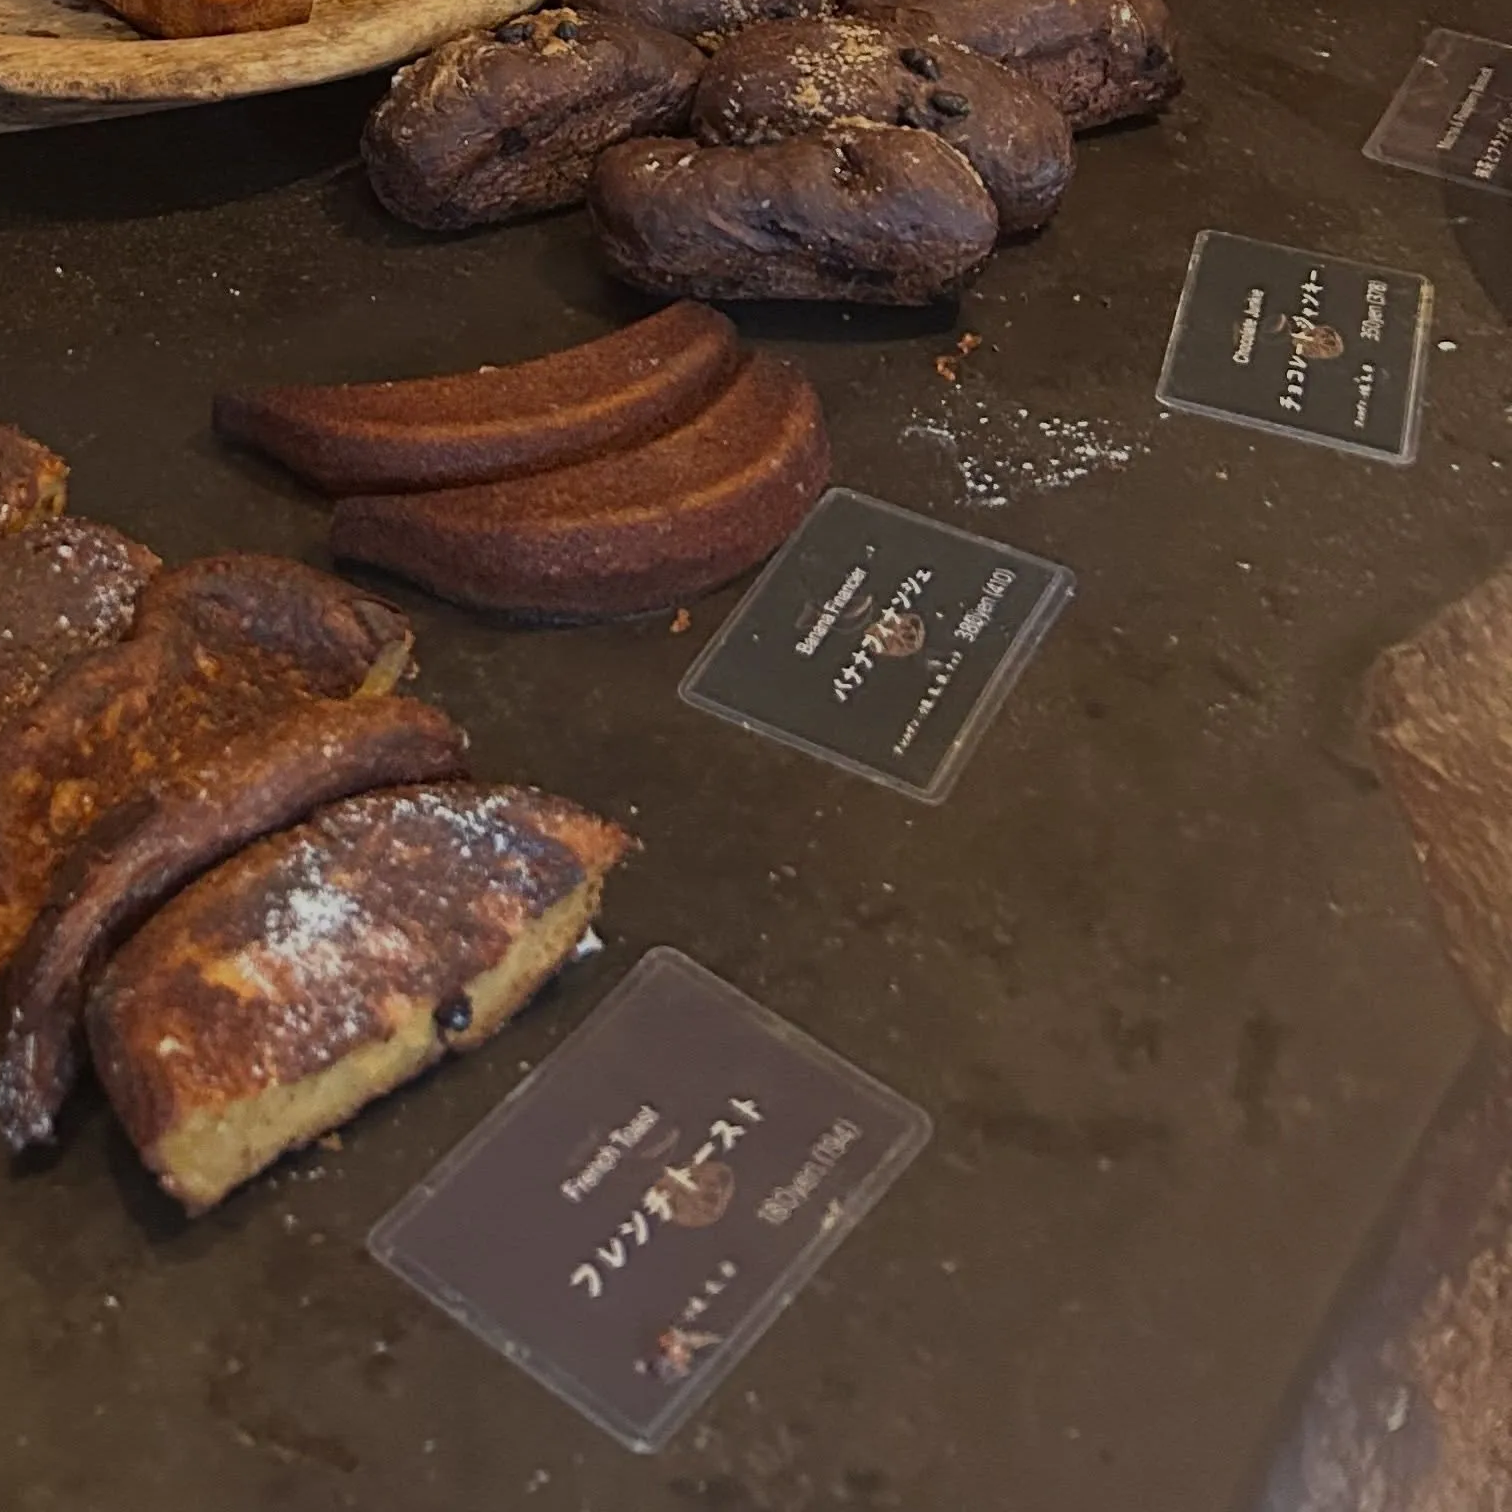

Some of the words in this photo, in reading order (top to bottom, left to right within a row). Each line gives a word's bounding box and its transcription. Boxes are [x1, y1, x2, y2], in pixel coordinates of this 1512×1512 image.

[1279, 270, 1324, 412] チョコレートジャンキー
[795, 606, 834, 656] Banana
[832, 568, 933, 703] バナナフィナンシェ
[983, 567, 1017, 600] (410)
[569, 1096, 765, 1297] フレンチトースト
